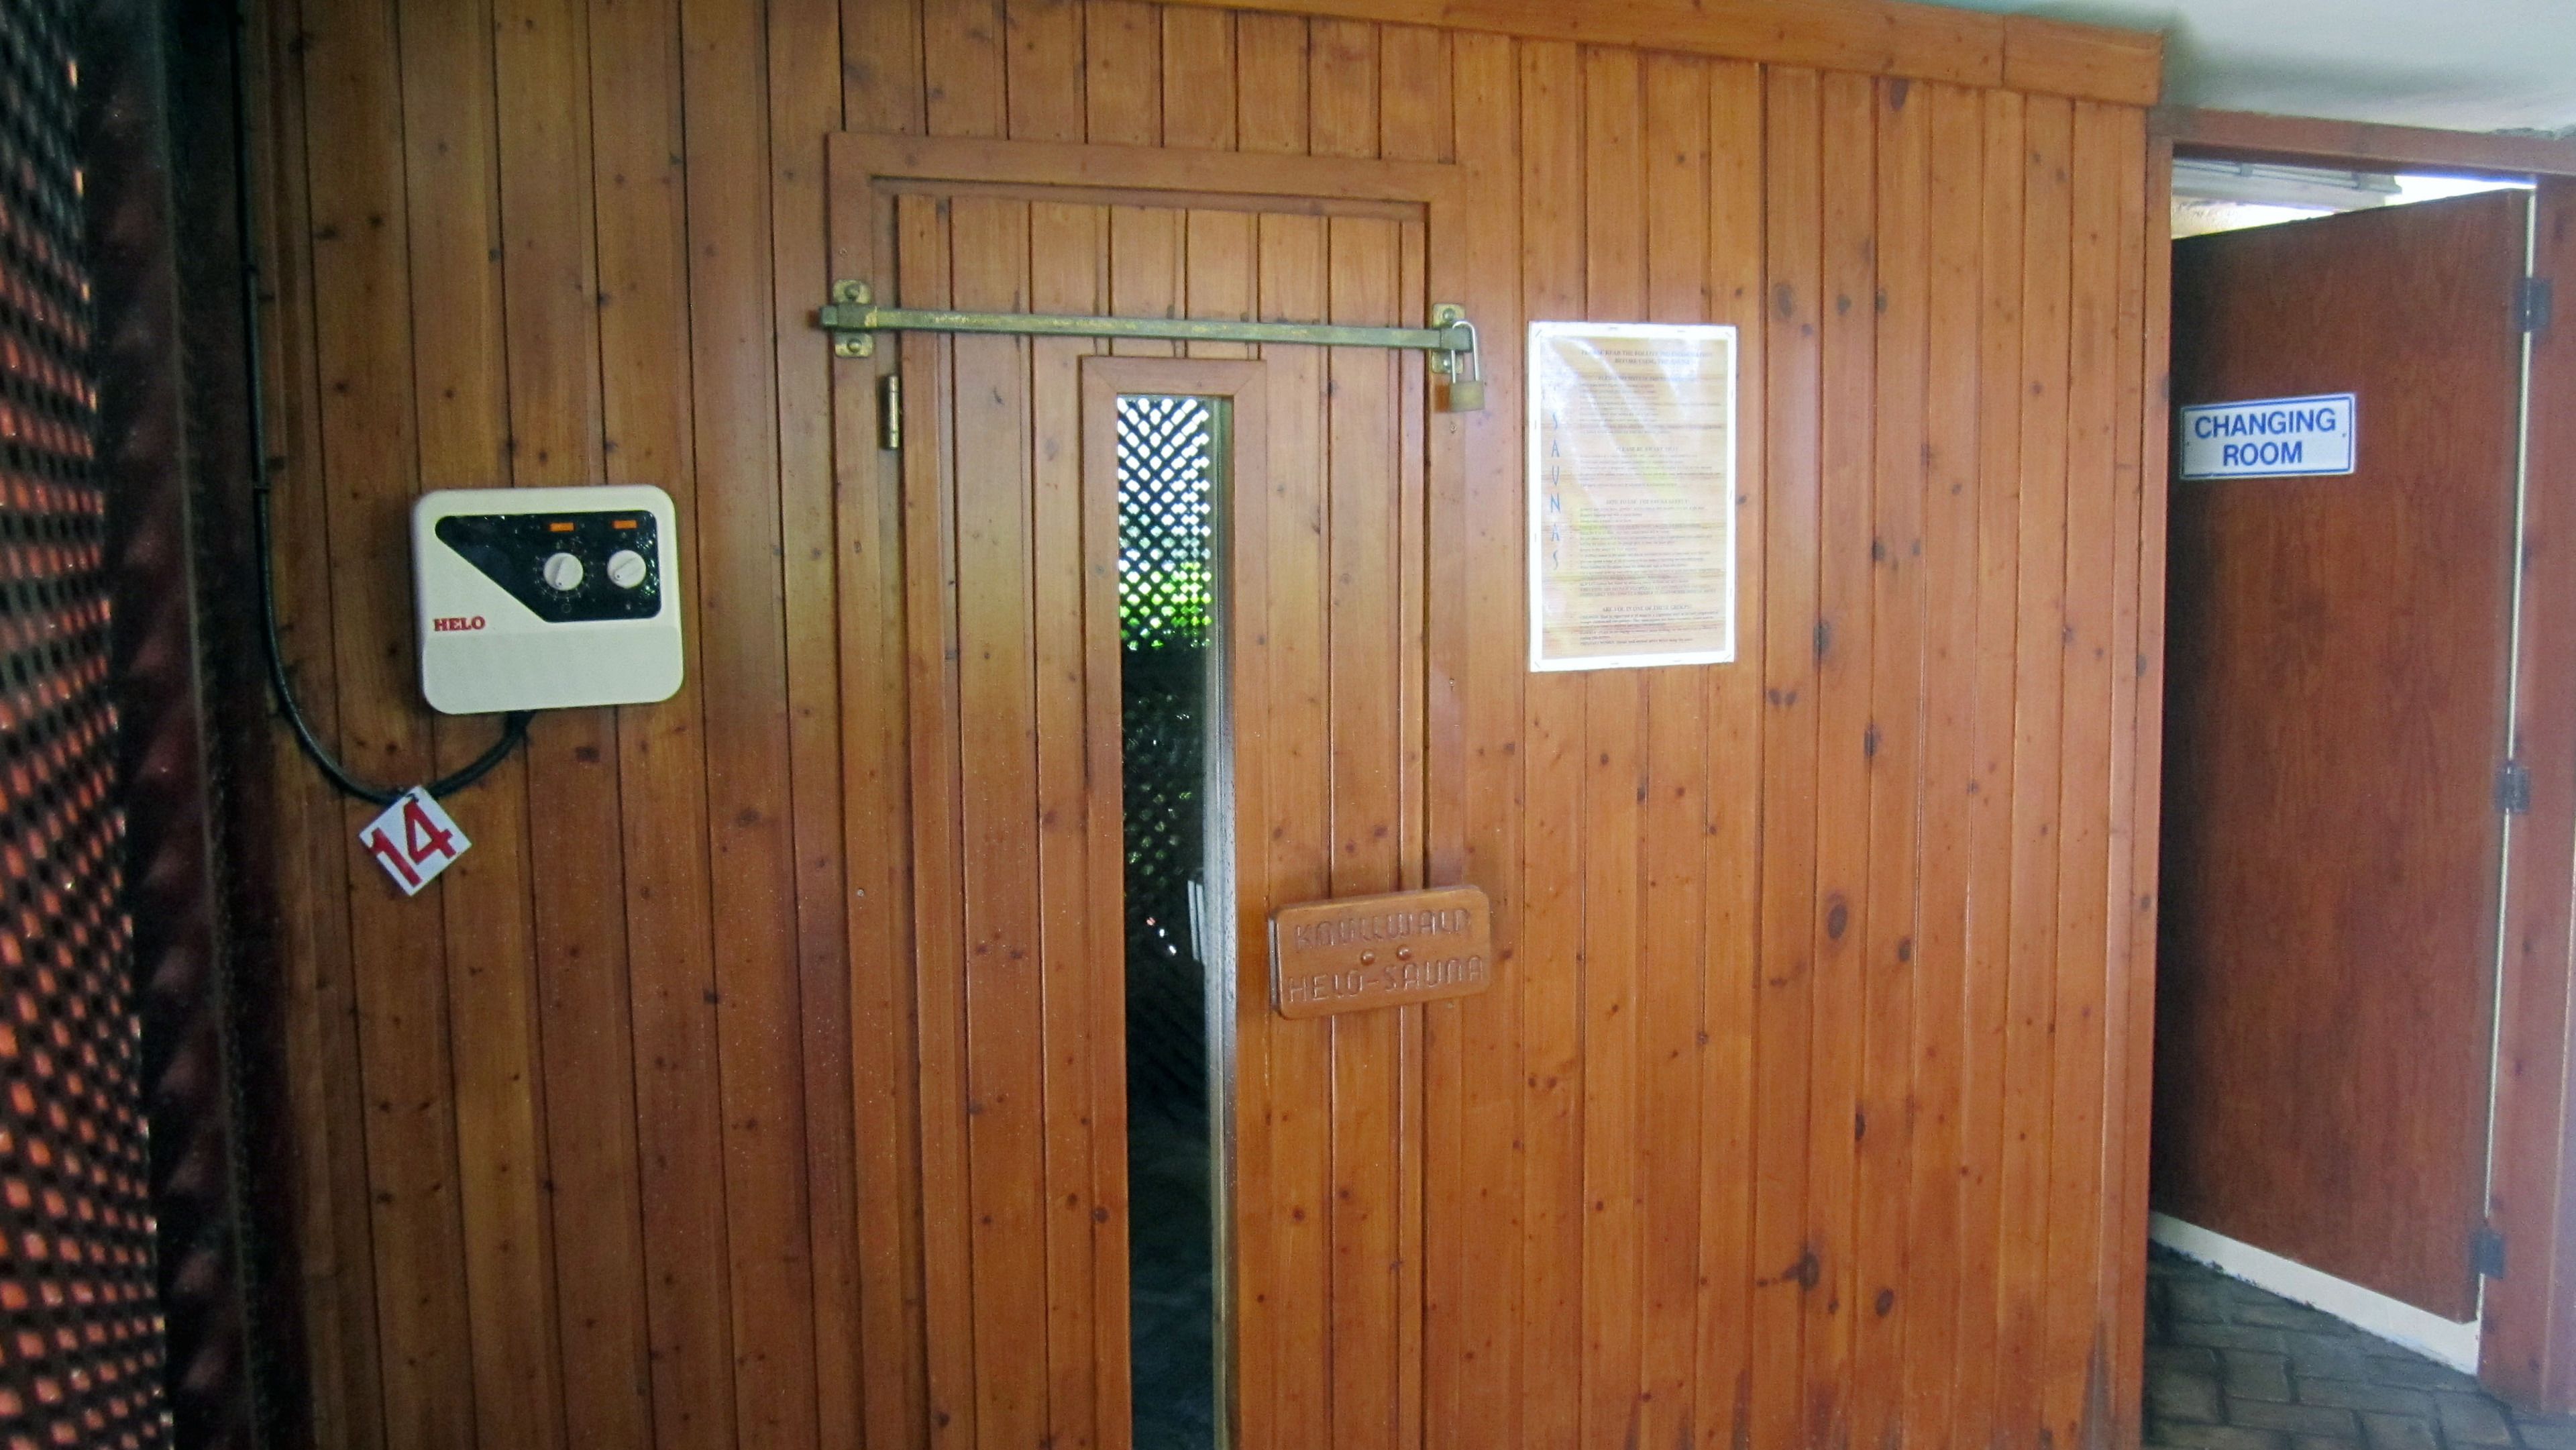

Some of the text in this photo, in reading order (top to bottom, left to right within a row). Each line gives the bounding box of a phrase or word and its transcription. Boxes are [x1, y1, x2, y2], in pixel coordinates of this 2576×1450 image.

[2194, 407, 2336, 439] CHANGING
[2222, 441, 2303, 466] ROOM
[433, 615, 486, 632] HELO
[368, 799, 457, 888] 14
